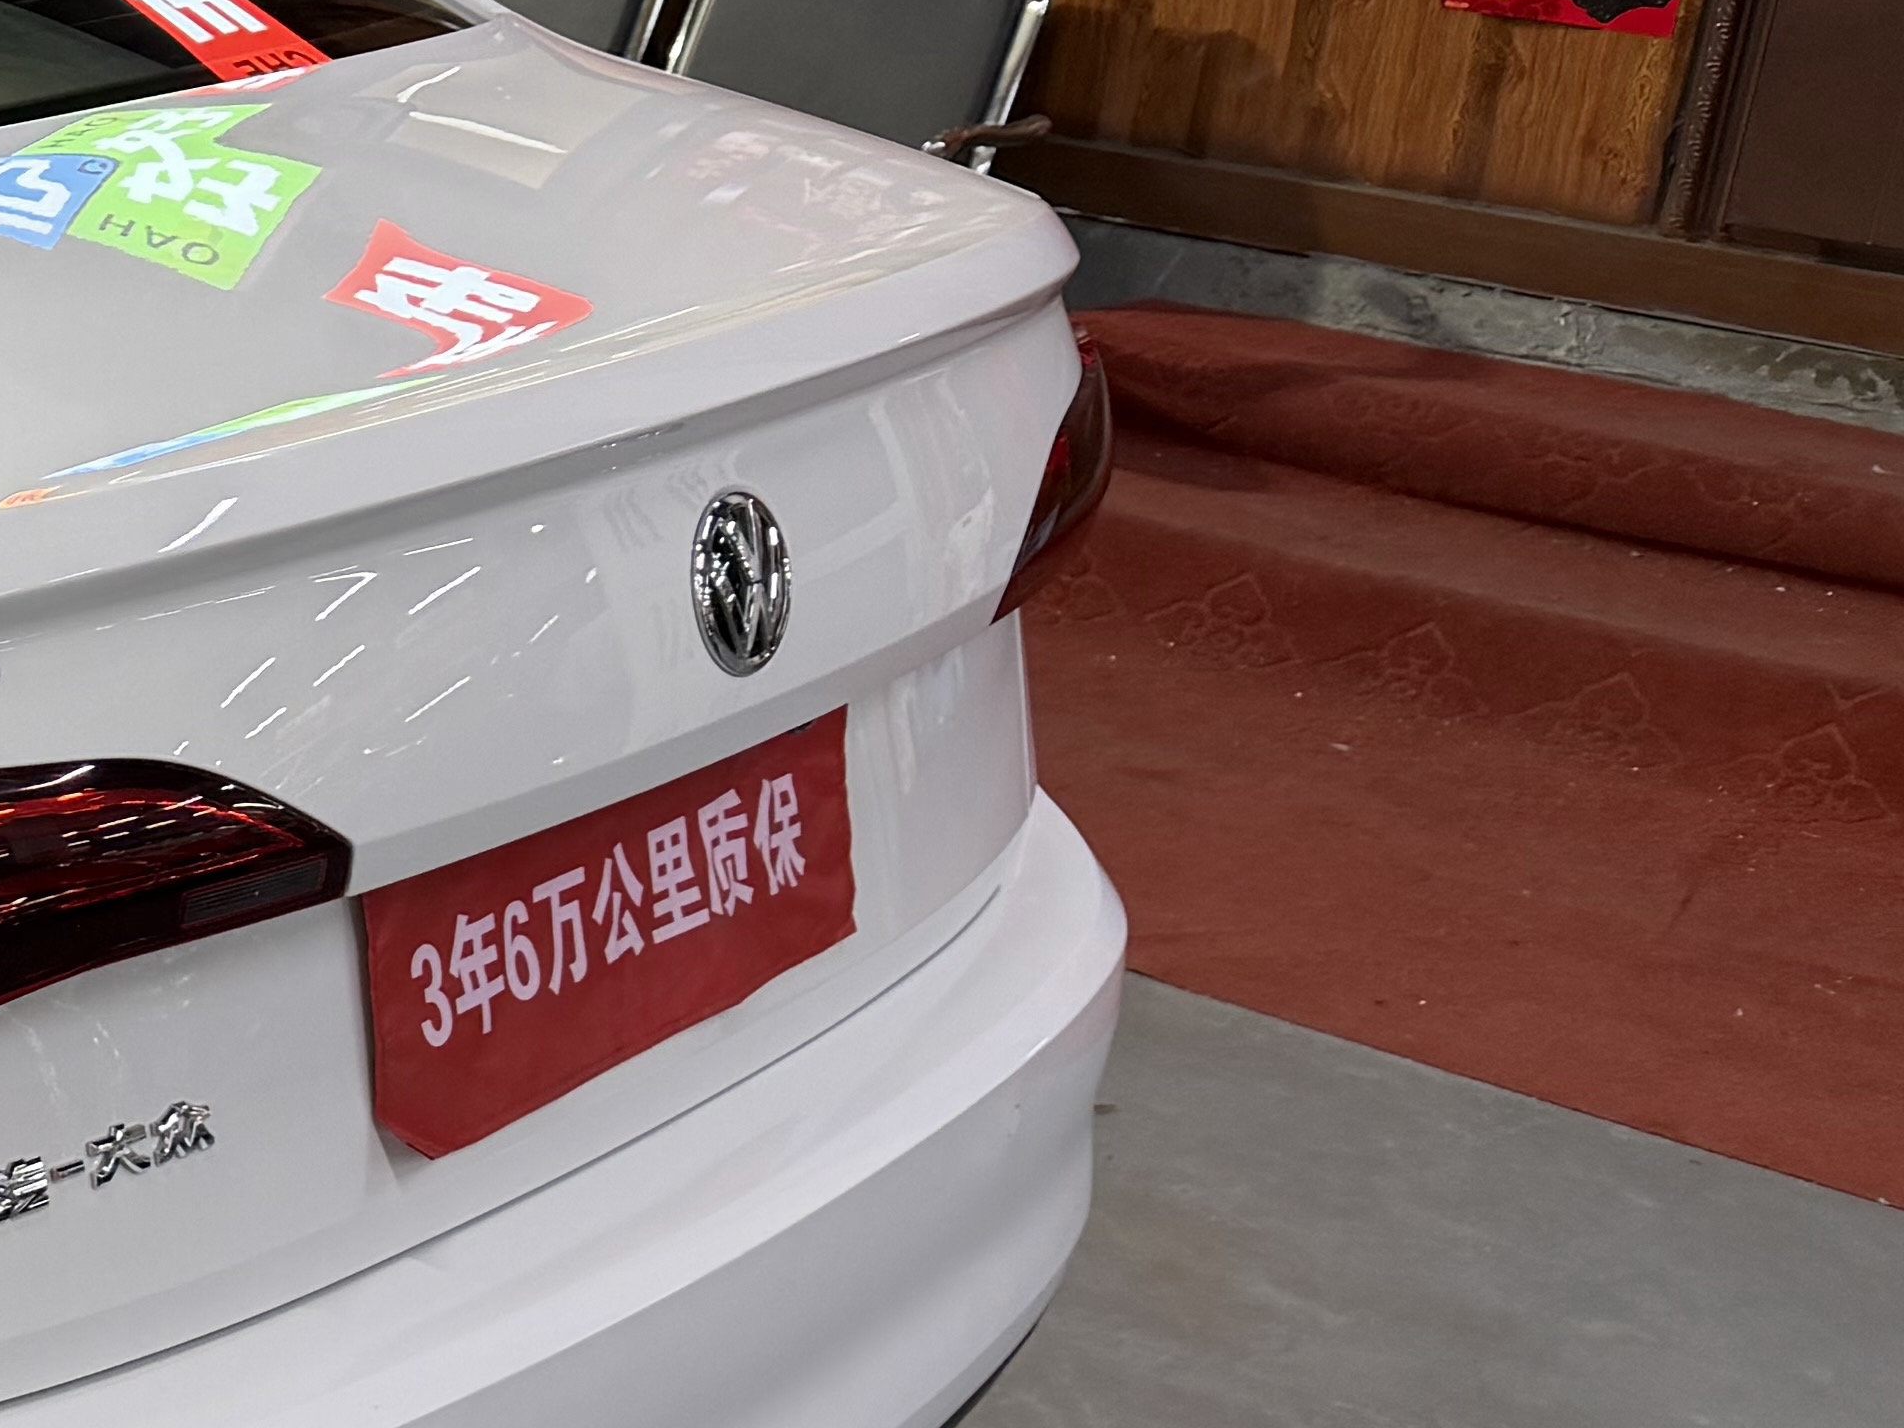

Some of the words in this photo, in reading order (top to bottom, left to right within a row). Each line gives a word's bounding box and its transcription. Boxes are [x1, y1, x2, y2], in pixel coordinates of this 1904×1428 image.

[409, 771, 807, 1049] 3年6万公里质保
